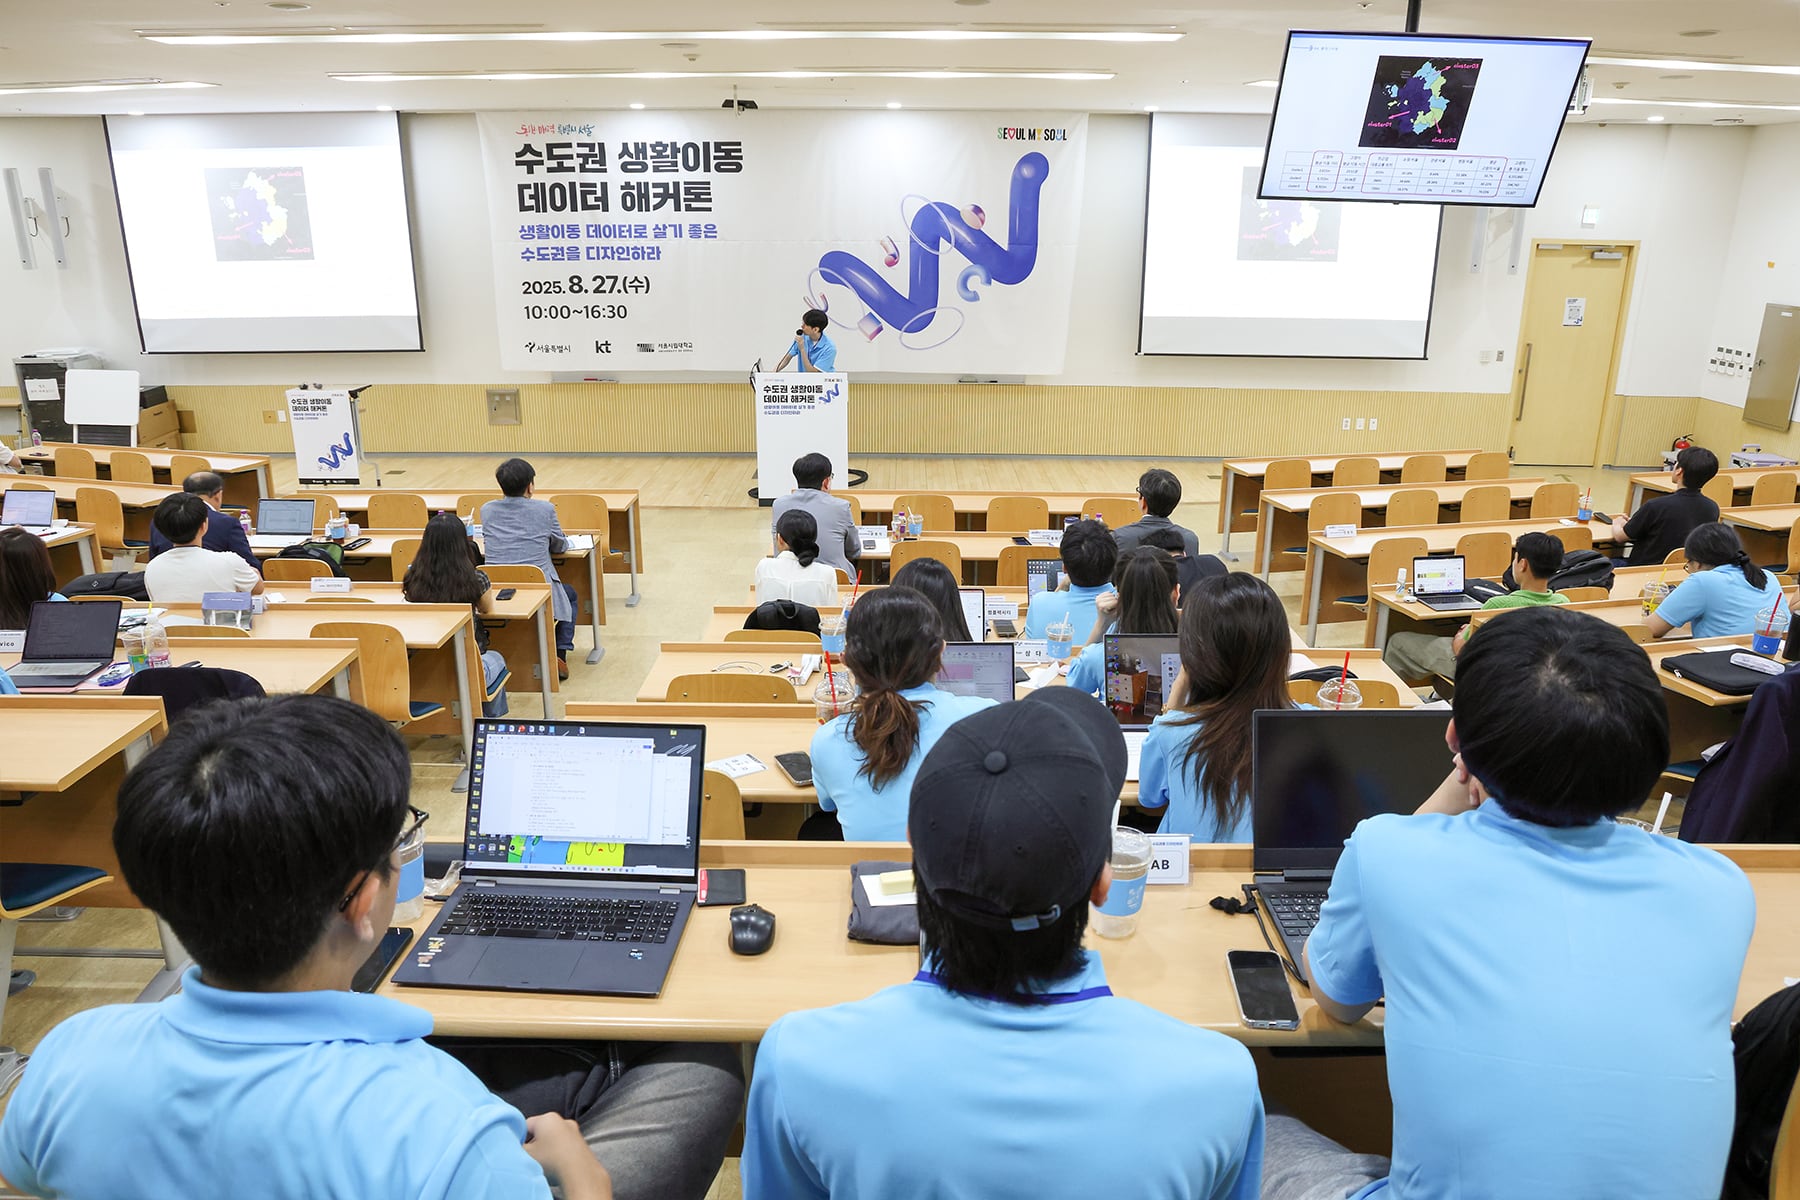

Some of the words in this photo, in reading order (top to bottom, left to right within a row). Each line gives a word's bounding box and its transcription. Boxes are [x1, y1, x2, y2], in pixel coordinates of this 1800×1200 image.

[515, 142, 608, 175] 수도권
[617, 140, 744, 174] 생활이동
[517, 181, 610, 213] 데이터
[620, 181, 713, 212] 해커톤
[518, 224, 581, 240] 생활이동
[586, 224, 648, 239] 데이터로
[652, 223, 683, 239] 살기
[688, 223, 718, 239] 좋은
[521, 247, 581, 262] 수도권을
[586, 246, 662, 261] 디자인하라
[521, 280, 566, 295] 2025.
[524, 304, 628, 320] 10:00~16:30
[537, 344, 571, 354] 서울특별시
[595, 340, 612, 353] kt
[763, 385, 788, 394] 수도권
[790, 384, 823, 394] 생활이동
[764, 395, 788, 403] 데이터
[790, 395, 815, 403] 해커톤
